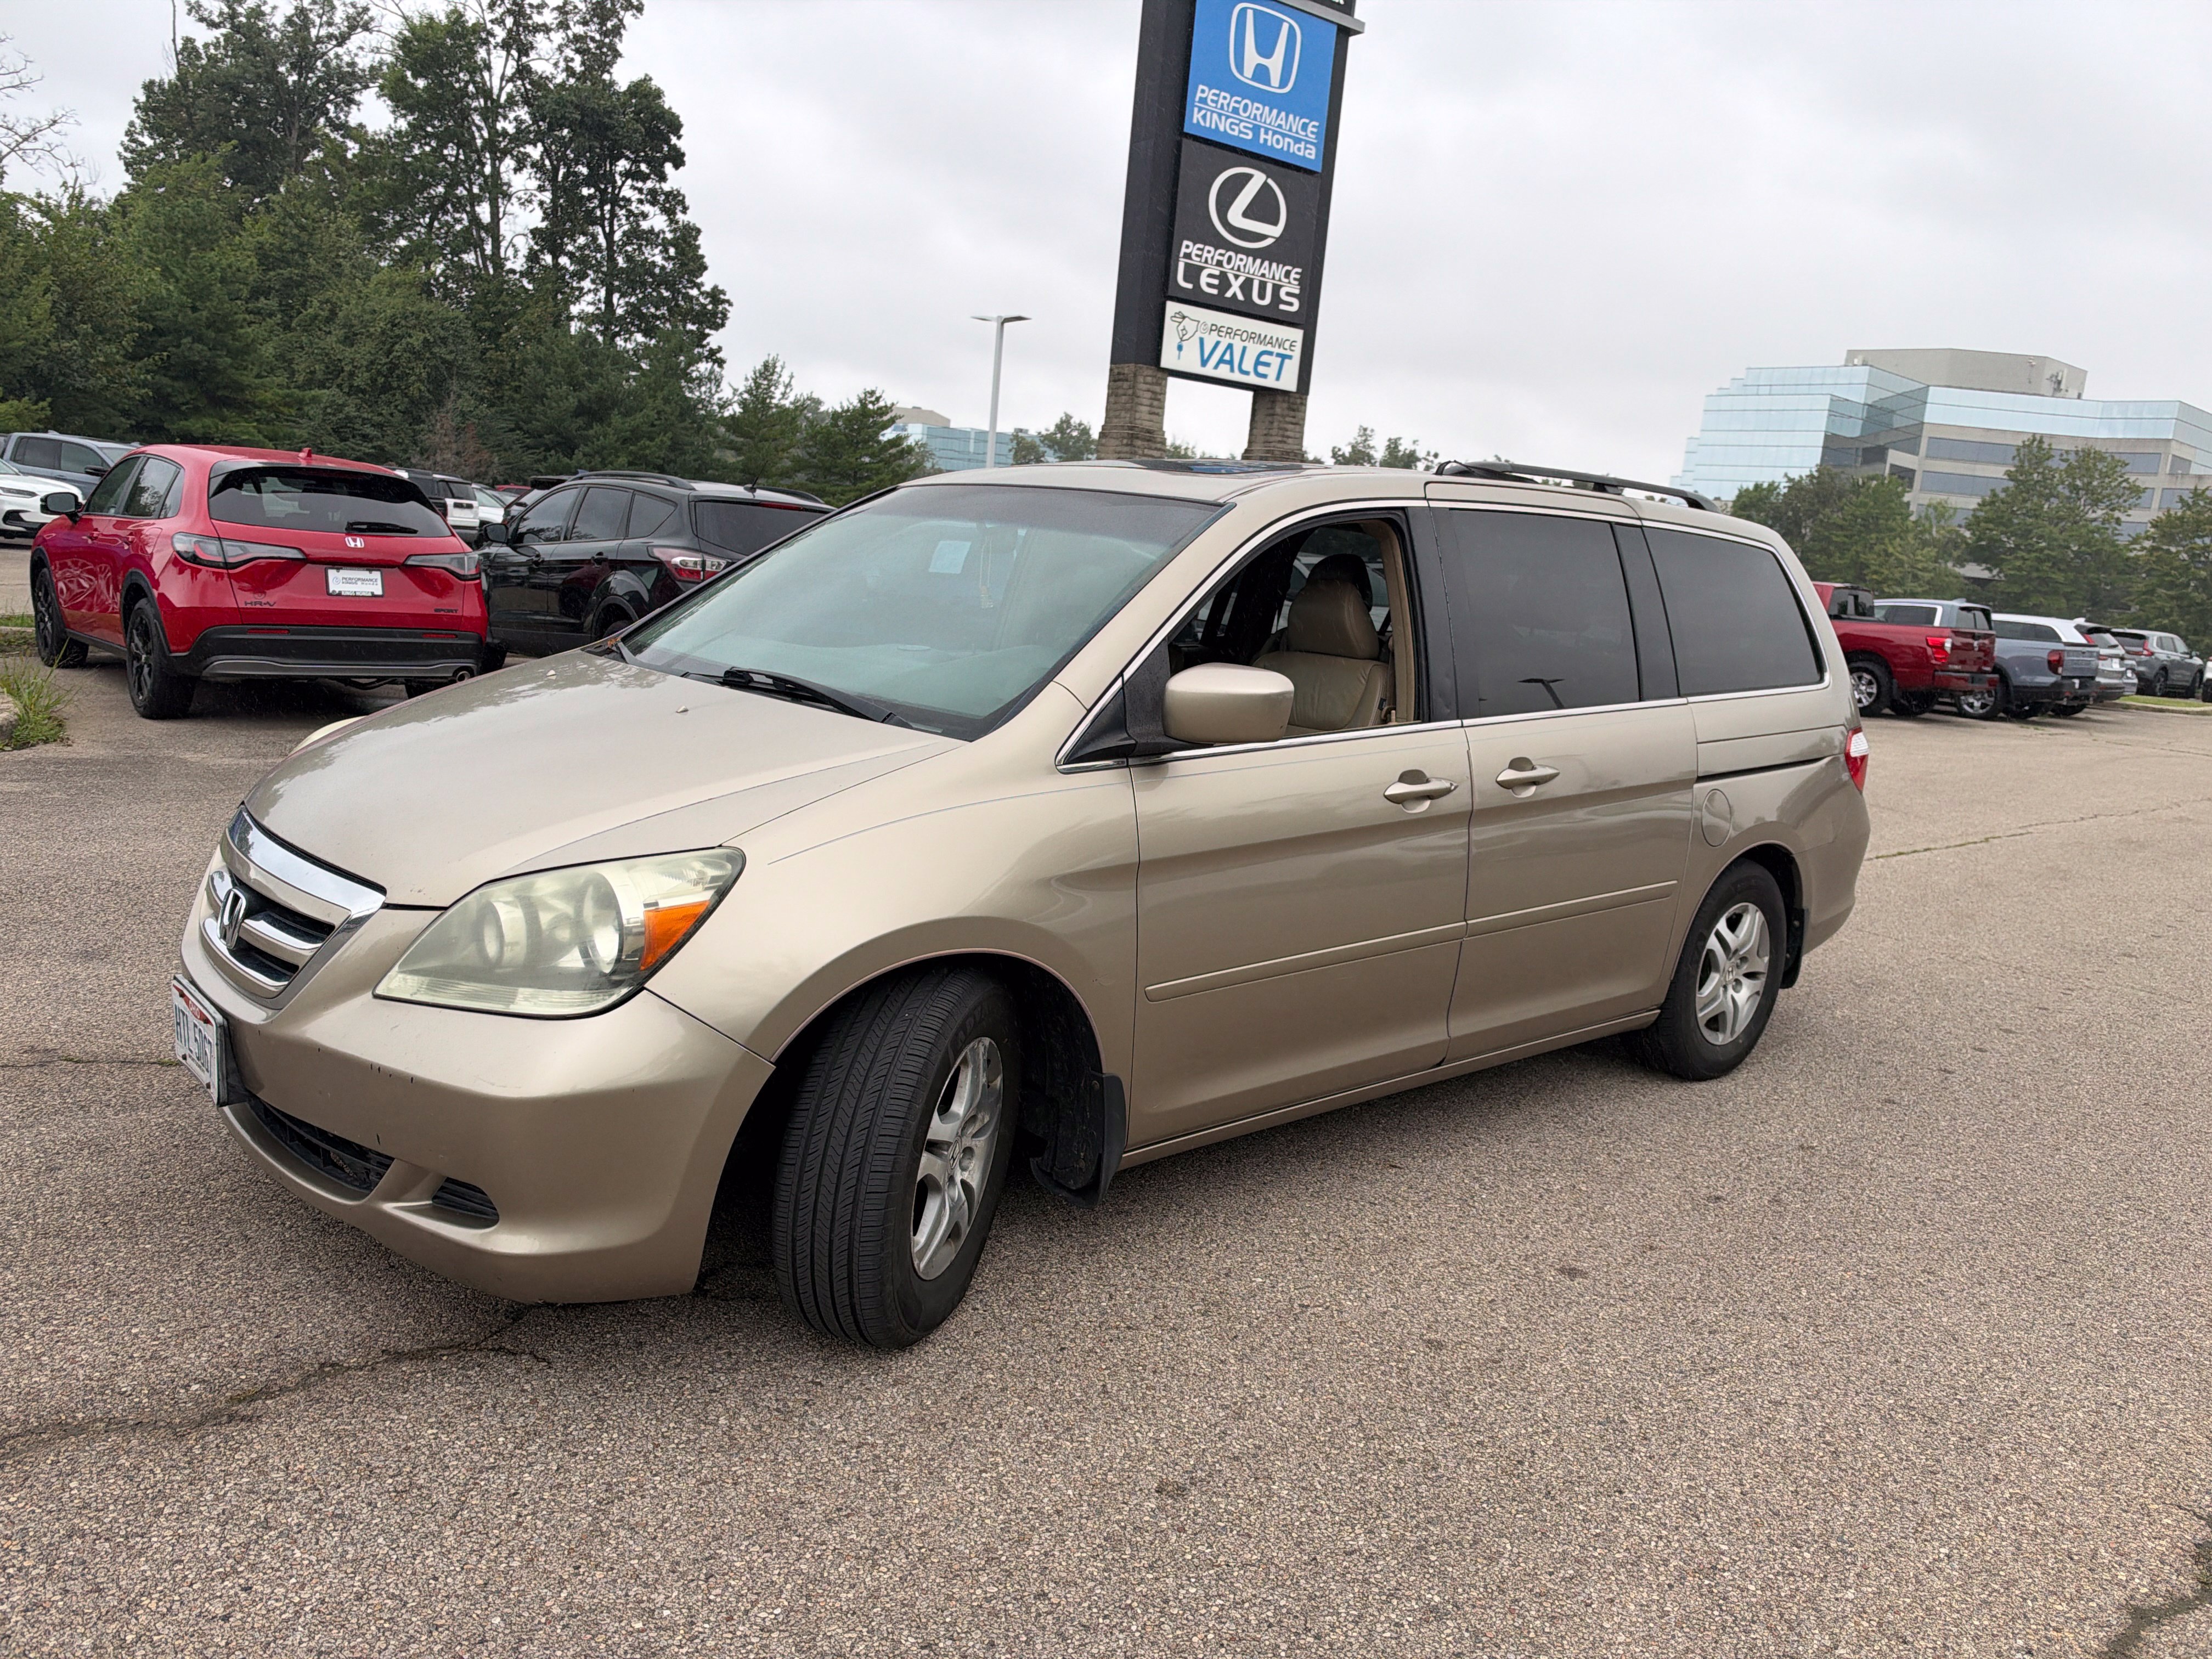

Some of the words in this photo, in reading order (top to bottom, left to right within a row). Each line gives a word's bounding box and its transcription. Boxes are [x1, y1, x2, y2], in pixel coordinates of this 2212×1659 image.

[1192, 107, 1254, 140] KINGS
[1259, 128, 1316, 160] Honda
[1194, 84, 1319, 139] PERFORMANCE
[1177, 261, 1301, 312] LEXUS
[1180, 240, 1302, 285] PERFORMANCE
[1199, 336, 1294, 382] VALET
[1209, 323, 1298, 352] PERFORMANCE
[189, 1000, 200, 1019] OHIO
[174, 1003, 193, 1054] HTL
[193, 1020, 212, 1079] 5067
